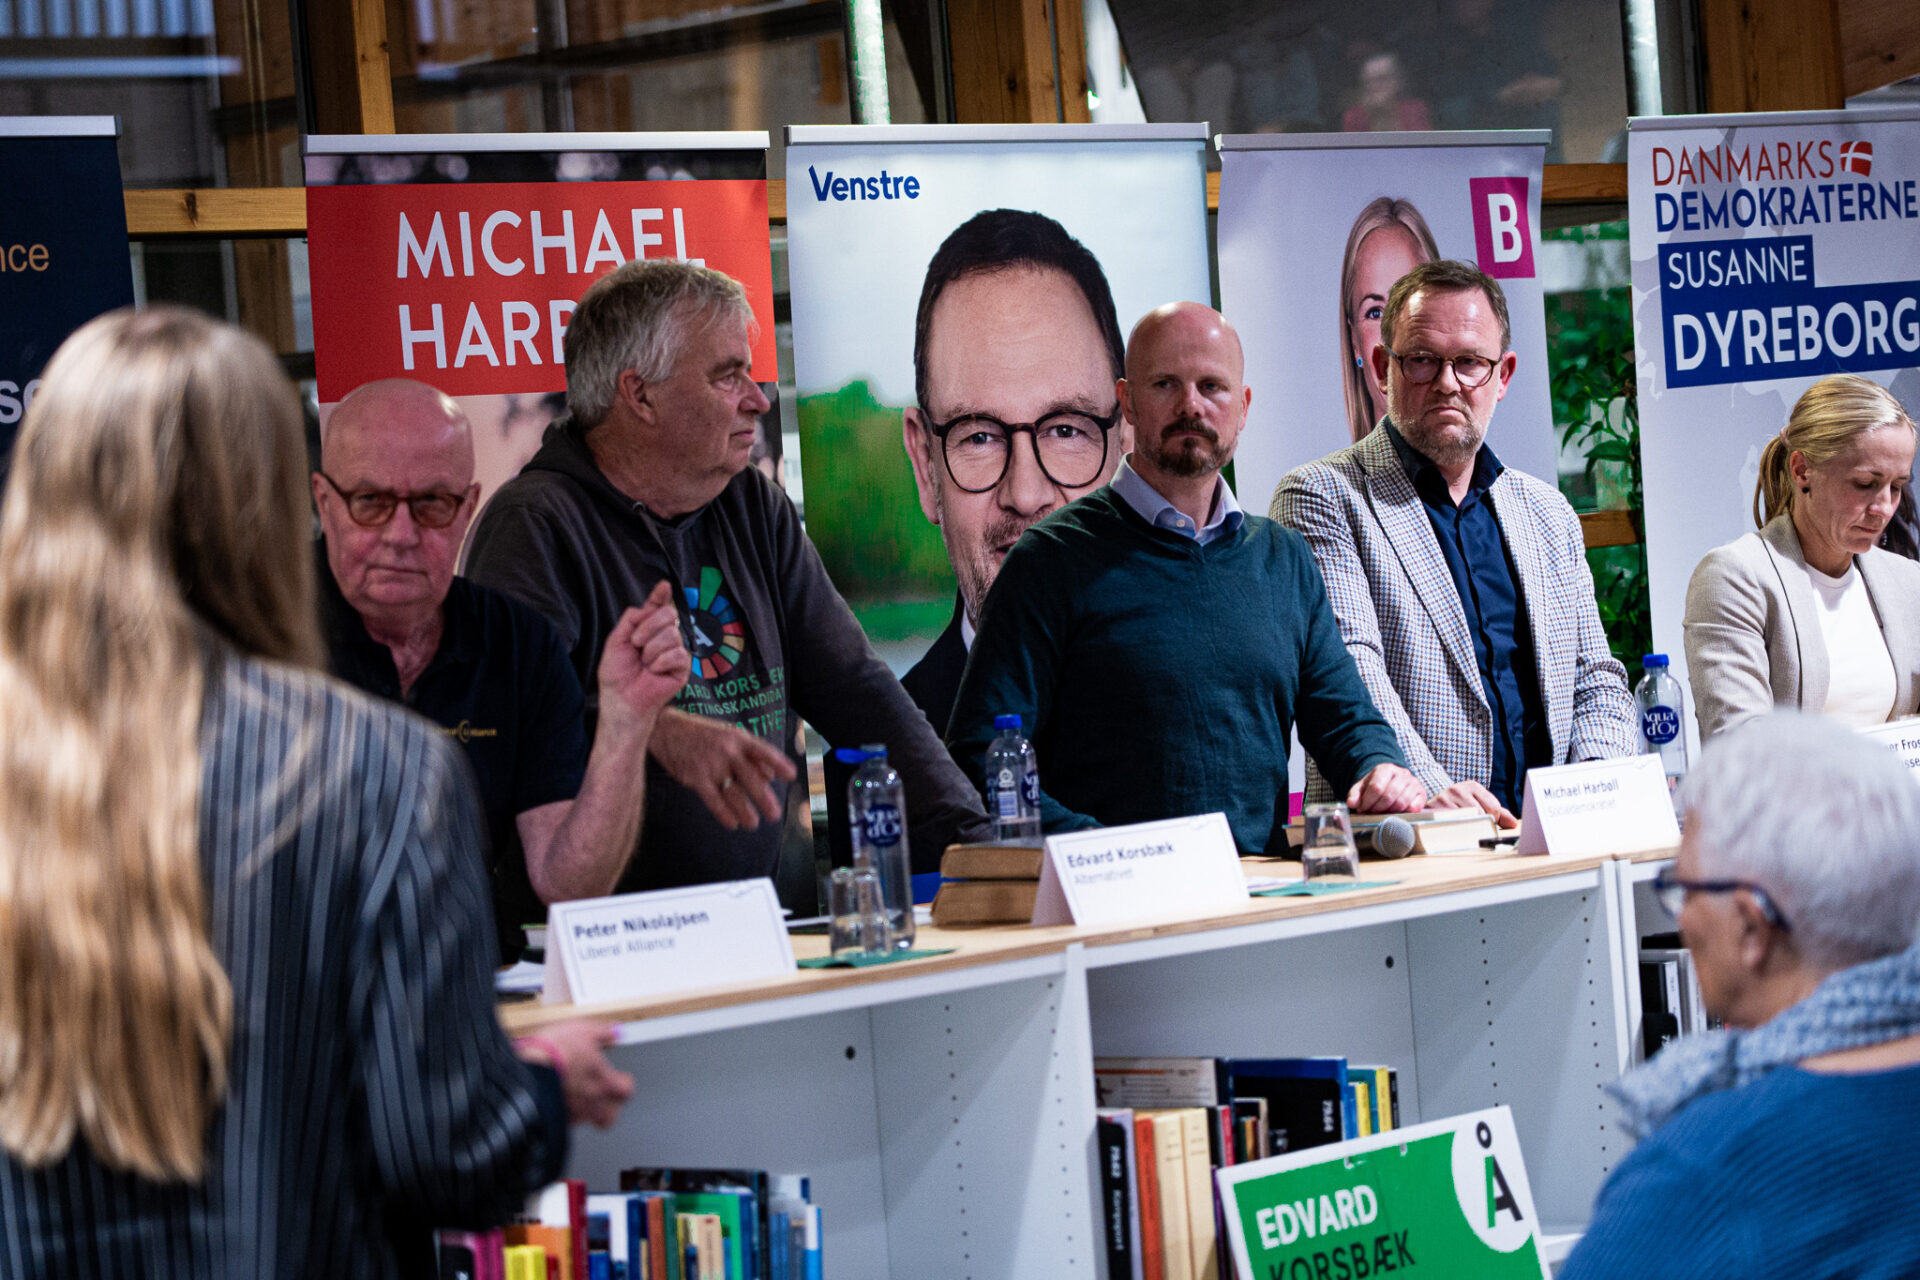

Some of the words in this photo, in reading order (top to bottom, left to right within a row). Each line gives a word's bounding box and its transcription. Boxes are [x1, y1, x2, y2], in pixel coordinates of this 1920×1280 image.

[808, 165, 920, 201] Venstre
[1652, 140, 1834, 187] DANMARKS
[1487, 192, 1523, 263] B
[1655, 180, 1919, 233] DEMOKRATERNE
[397, 207, 706, 279] MICHAEL
[1668, 245, 1808, 290] SUSANNE
[1673, 297, 1920, 371] DYREBORG
[1543, 782, 1581, 800] Michael
[1067, 849, 1114, 868] Edvard
[1116, 841, 1176, 861] Korsbæk
[574, 924, 617, 939] Peter
[1256, 1184, 1378, 1250] EDVARD
